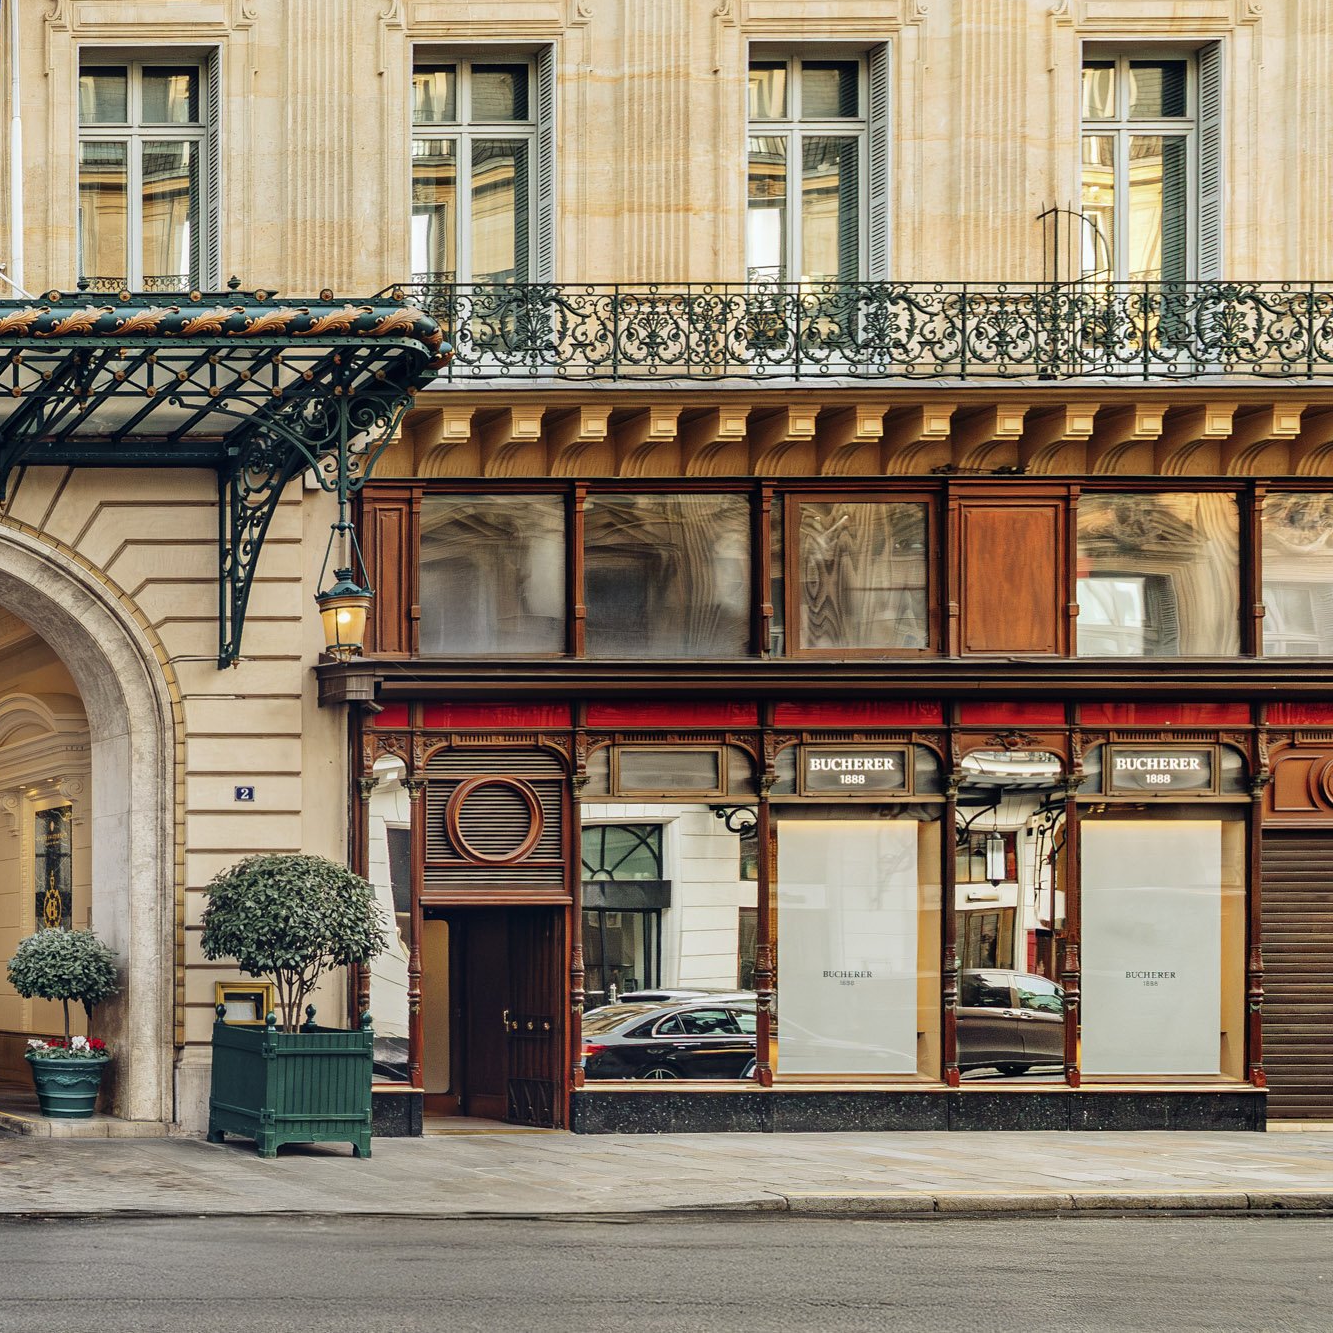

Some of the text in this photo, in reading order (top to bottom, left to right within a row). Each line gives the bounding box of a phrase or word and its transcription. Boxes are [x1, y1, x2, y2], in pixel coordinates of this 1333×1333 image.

[810, 758, 895, 771] BUCHERER
[1116, 758, 1201, 770] BUCHERER
[840, 774, 865, 784] 1888
[1145, 774, 1171, 784] 1888
[240, 788, 249, 799] 2
[823, 970, 873, 978] BUCHERER
[1125, 971, 1176, 979] BUCHERER
